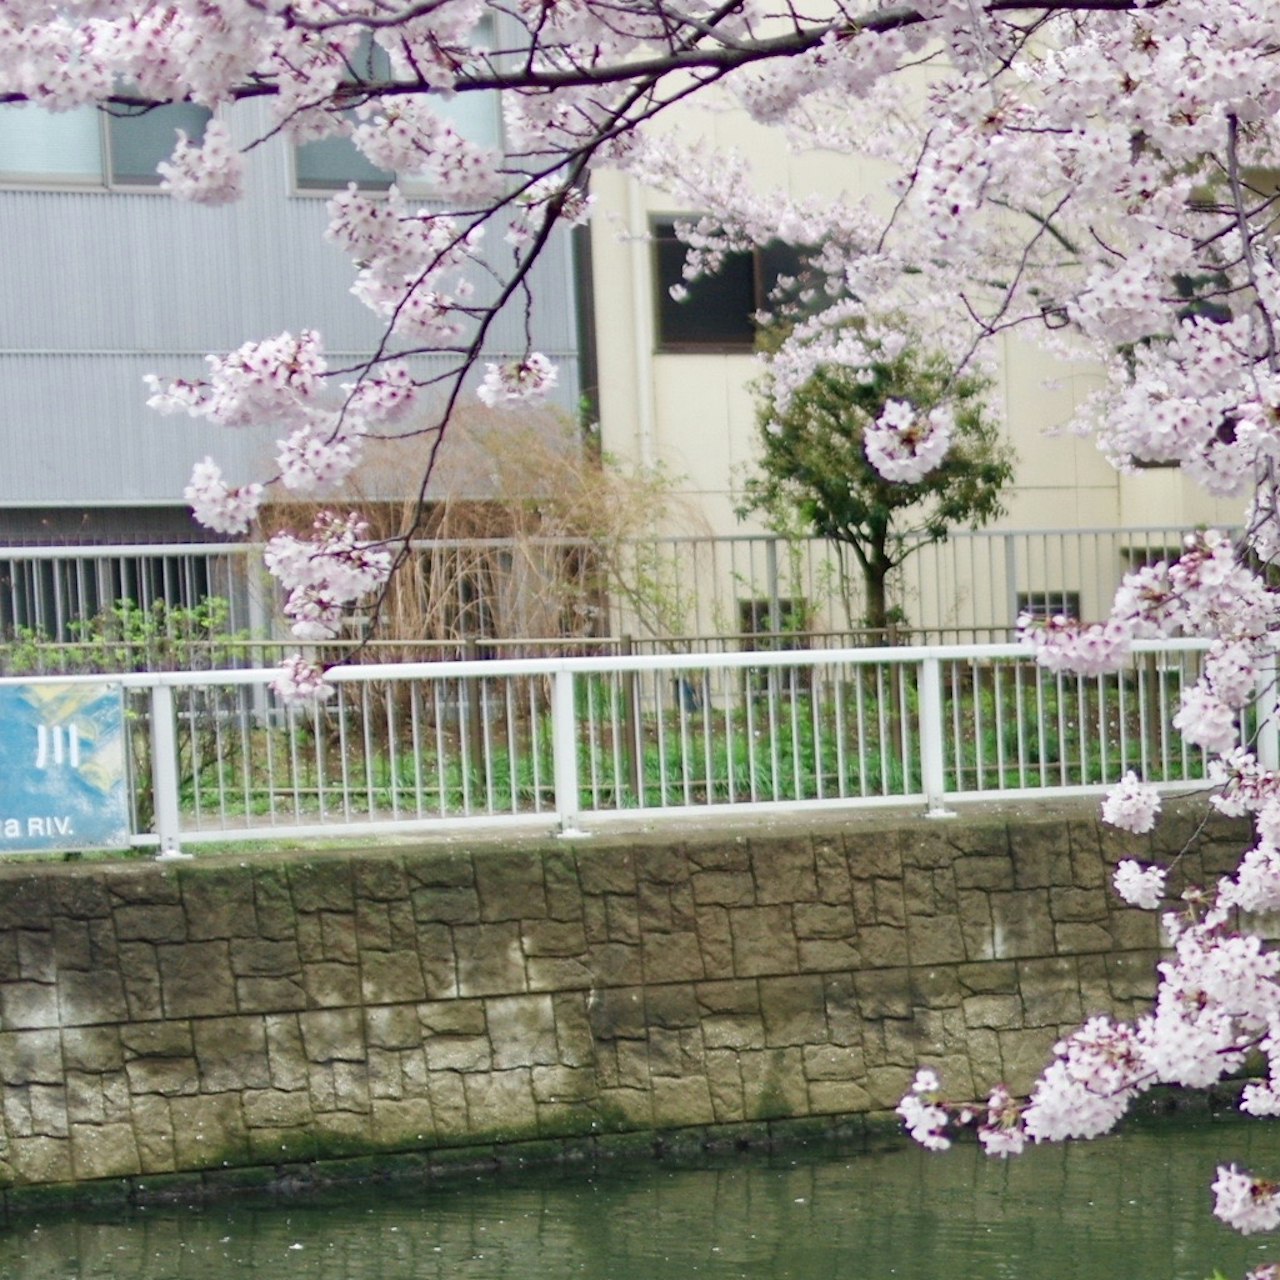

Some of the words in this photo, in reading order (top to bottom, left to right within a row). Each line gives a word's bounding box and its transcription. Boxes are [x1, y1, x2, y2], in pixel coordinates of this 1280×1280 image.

[36, 723, 79, 769] 川
[0, 817, 20, 838] a
[28, 816, 74, 837] RIV.
